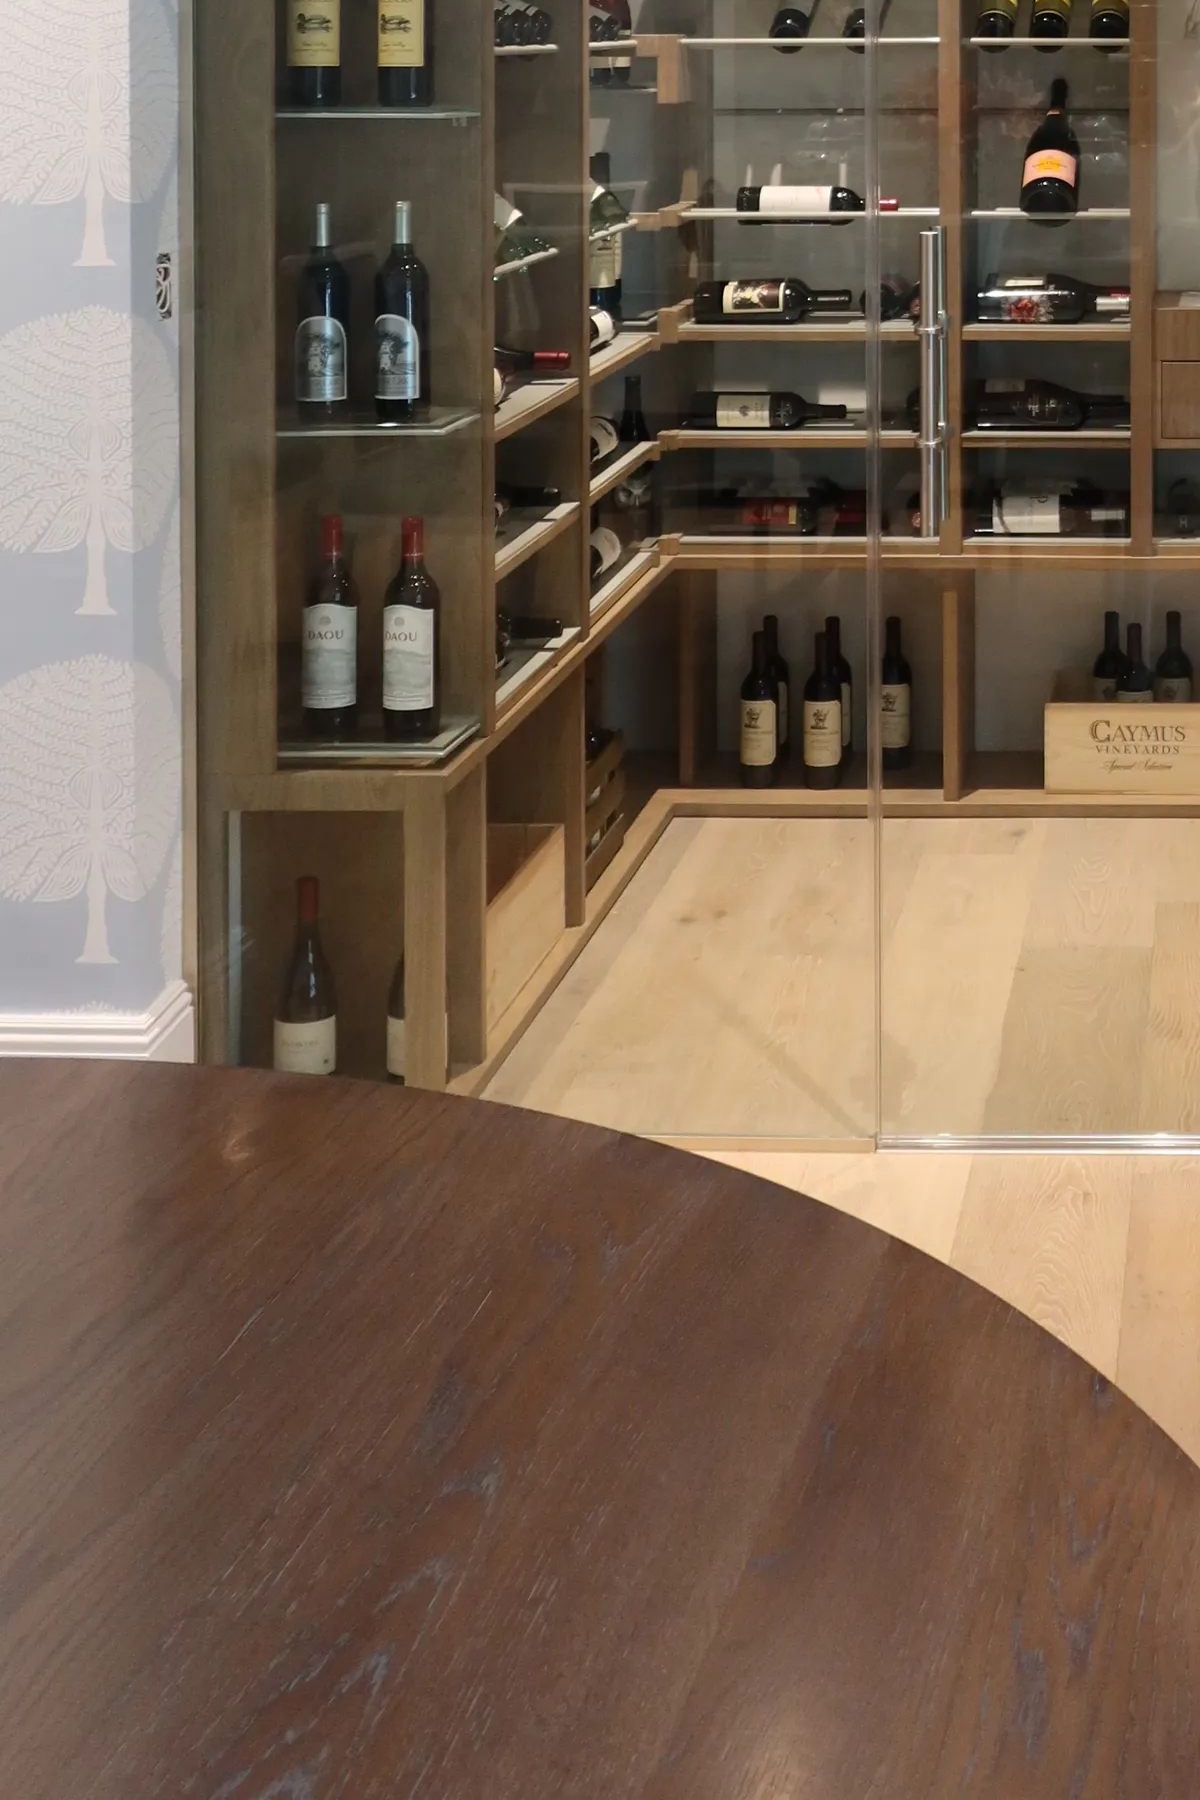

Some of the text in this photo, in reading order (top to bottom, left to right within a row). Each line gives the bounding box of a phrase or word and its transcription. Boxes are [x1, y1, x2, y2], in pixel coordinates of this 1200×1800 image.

[308, 630, 344, 641] DAOU
[384, 630, 417, 642] DAOU
[1089, 719, 1186, 743] CAYMUS
[1095, 744, 1180, 755] VINEYARDS
